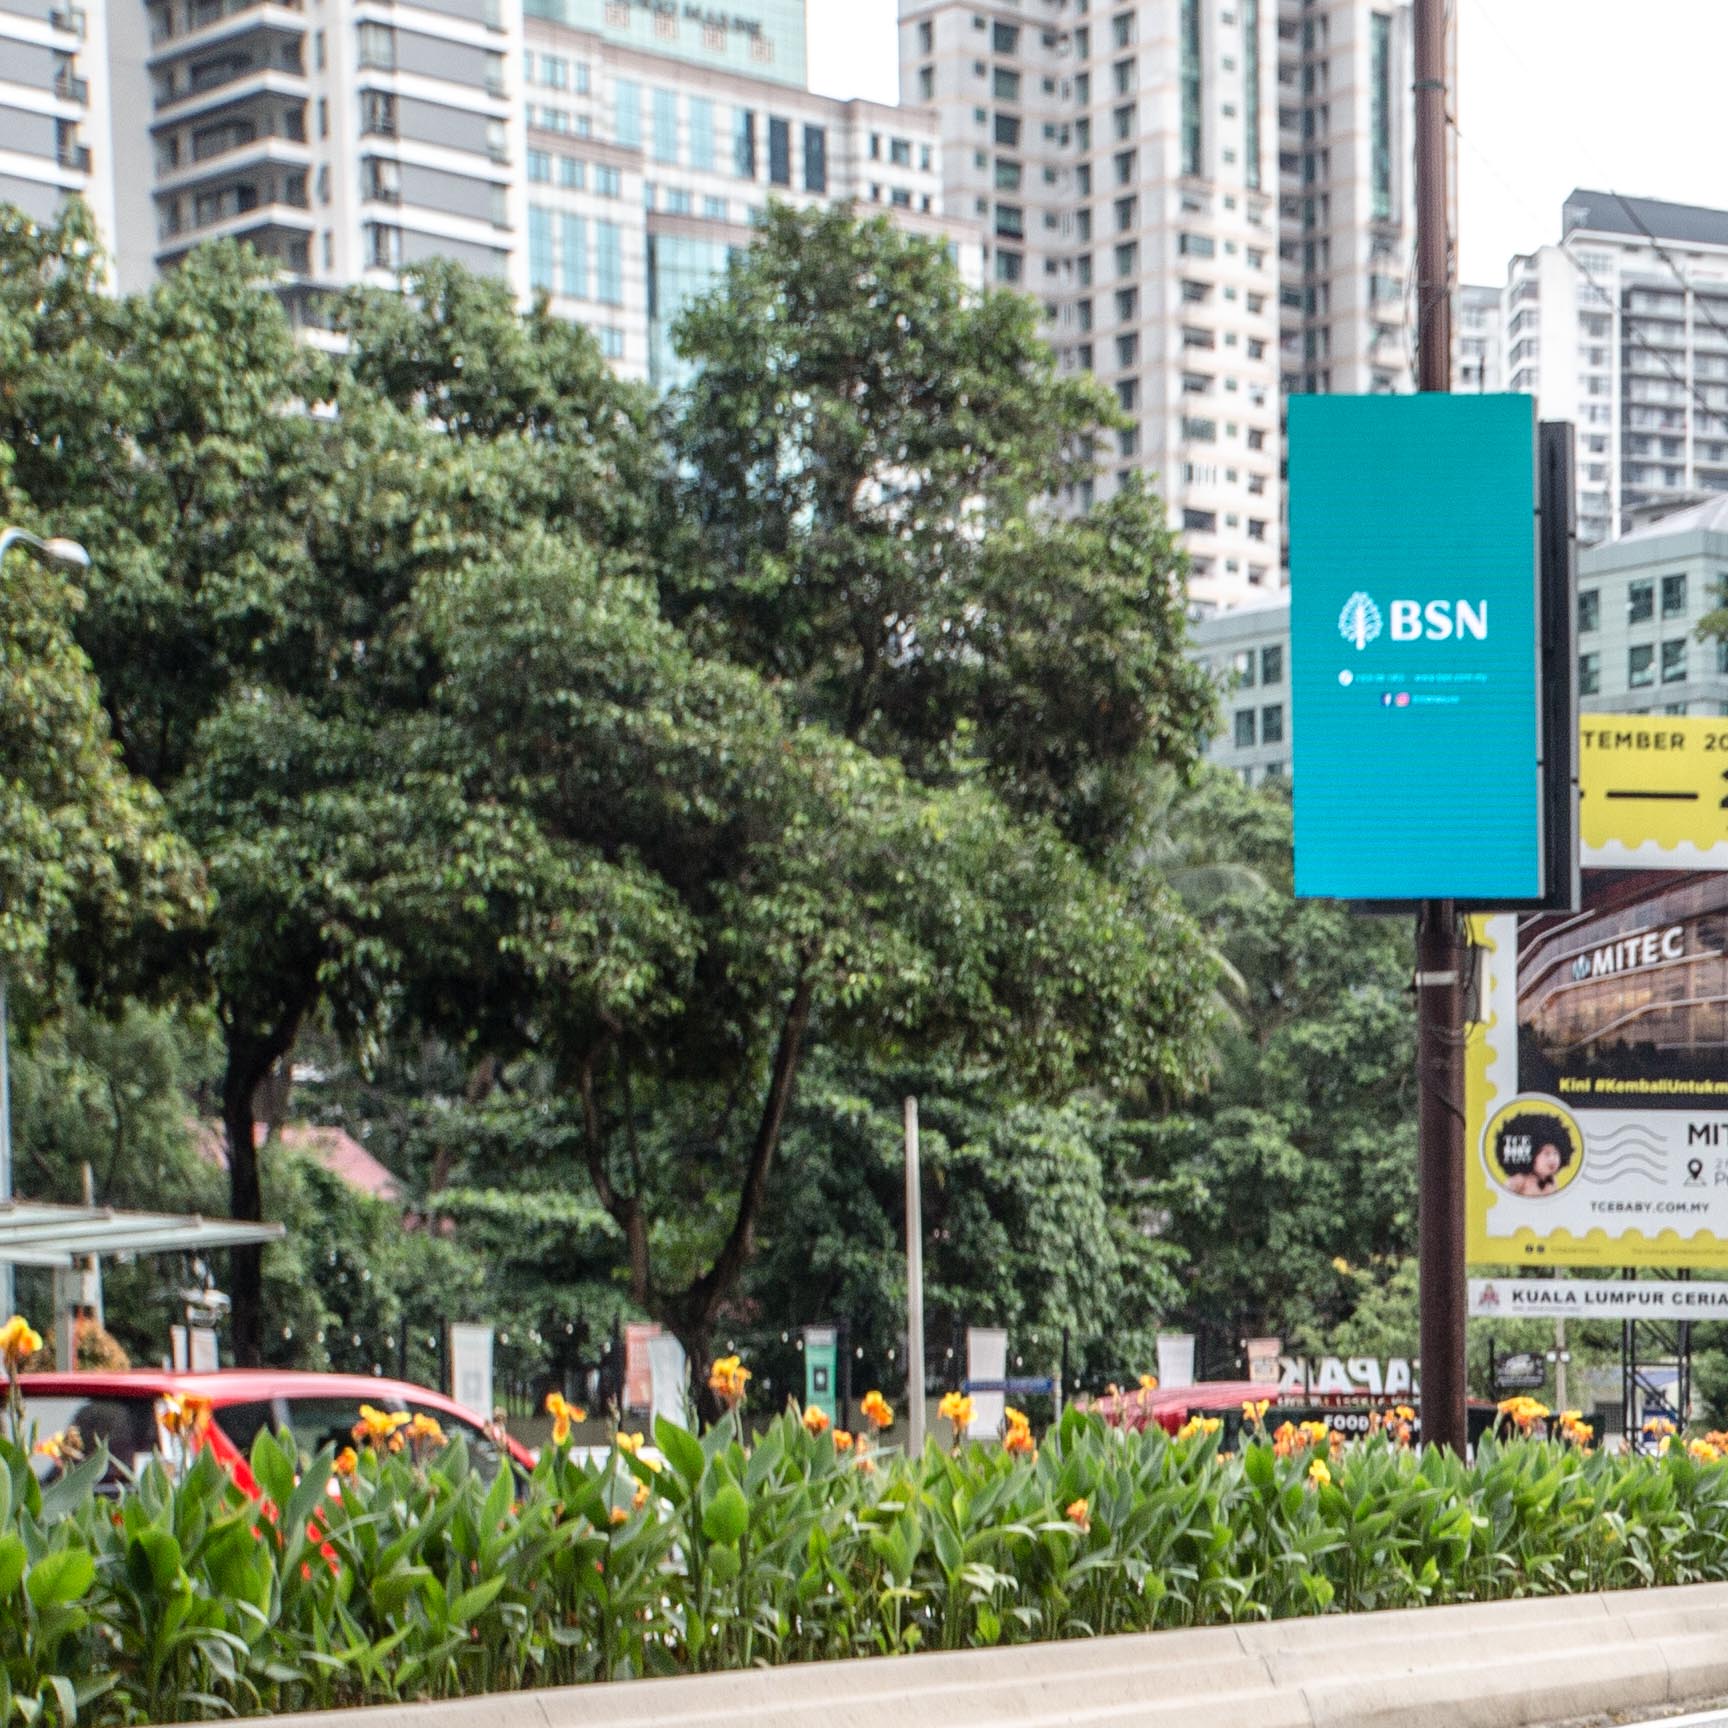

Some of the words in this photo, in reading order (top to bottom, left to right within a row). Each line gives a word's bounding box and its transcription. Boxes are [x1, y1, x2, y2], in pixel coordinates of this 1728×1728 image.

[1389, 599, 1488, 641] BSN
[1582, 730, 1685, 750] TEMBER
[1591, 926, 1684, 978] MITEC
[1559, 1077, 1591, 1093] Kini
[1590, 1202, 1710, 1214] TCEBABY.COM.MY
[1511, 1289, 1577, 1306] KUALA
[1584, 1290, 1665, 1306] LUMPUR
[1324, 1413, 1370, 1432] FOOD
